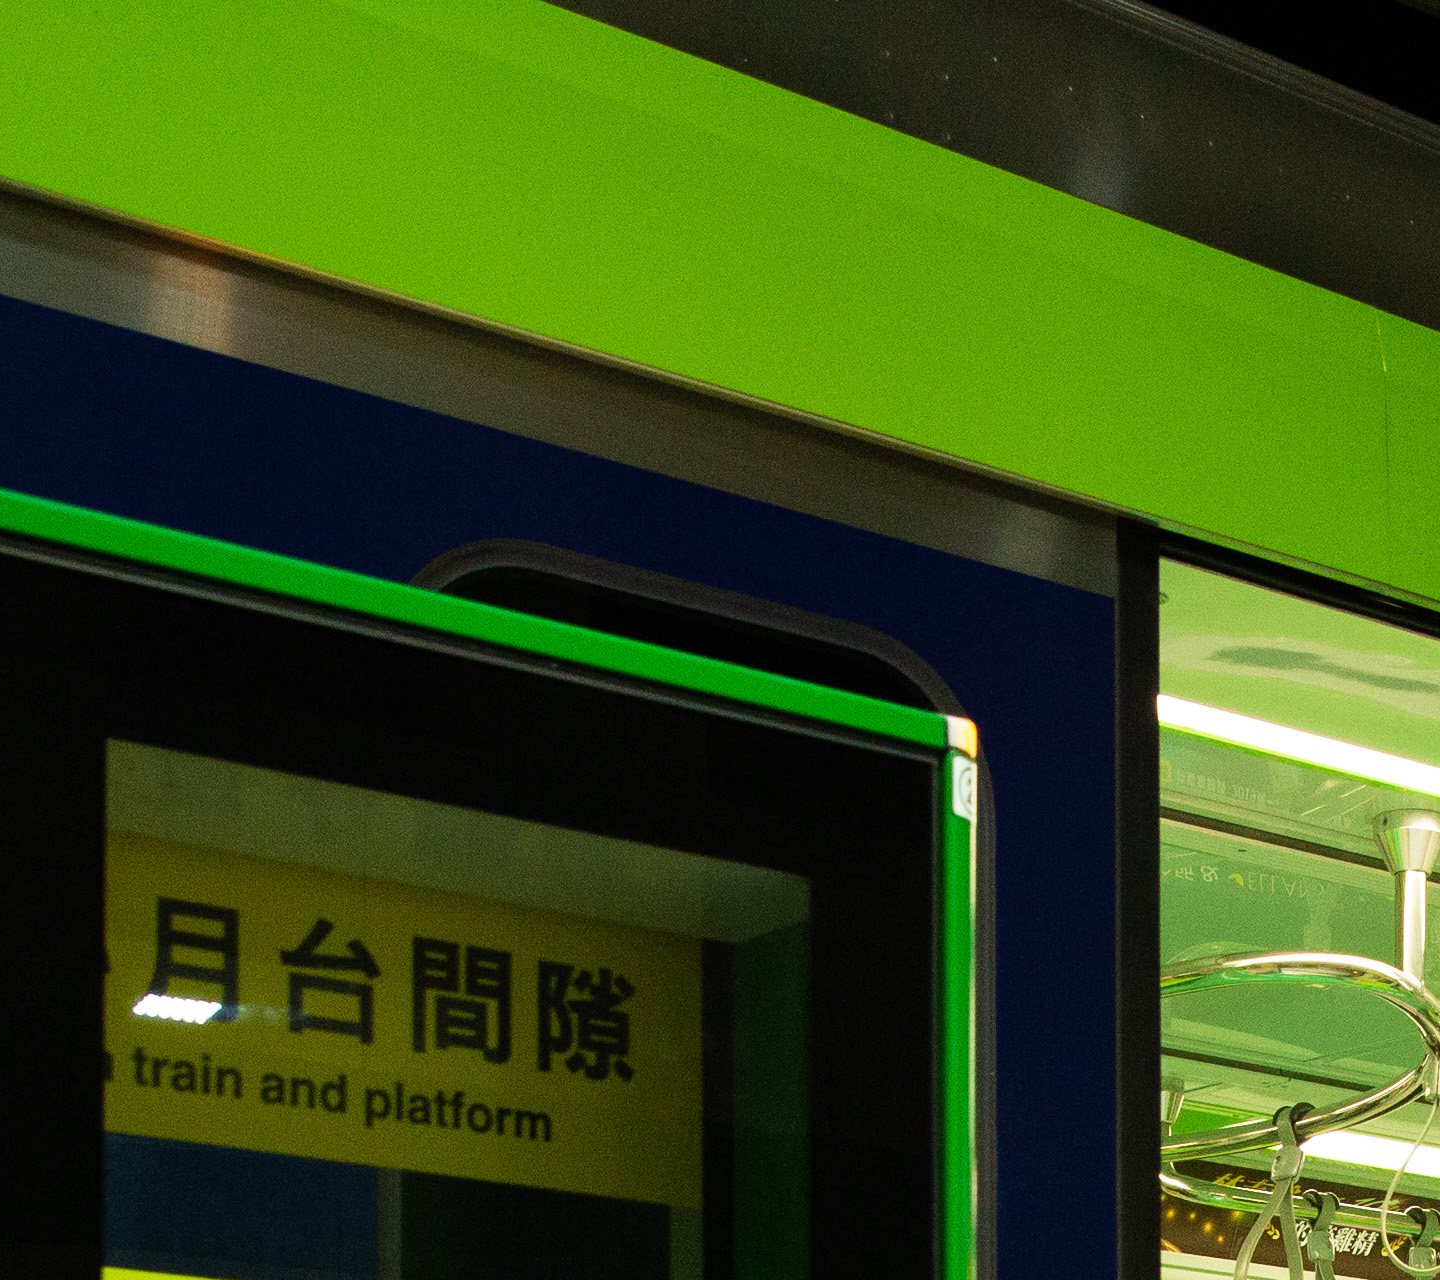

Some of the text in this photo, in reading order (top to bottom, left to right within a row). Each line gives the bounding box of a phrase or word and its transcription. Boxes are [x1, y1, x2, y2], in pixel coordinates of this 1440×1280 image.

[147, 896, 636, 1083] 月台間隙
[131, 1045, 553, 1143] train and platform
